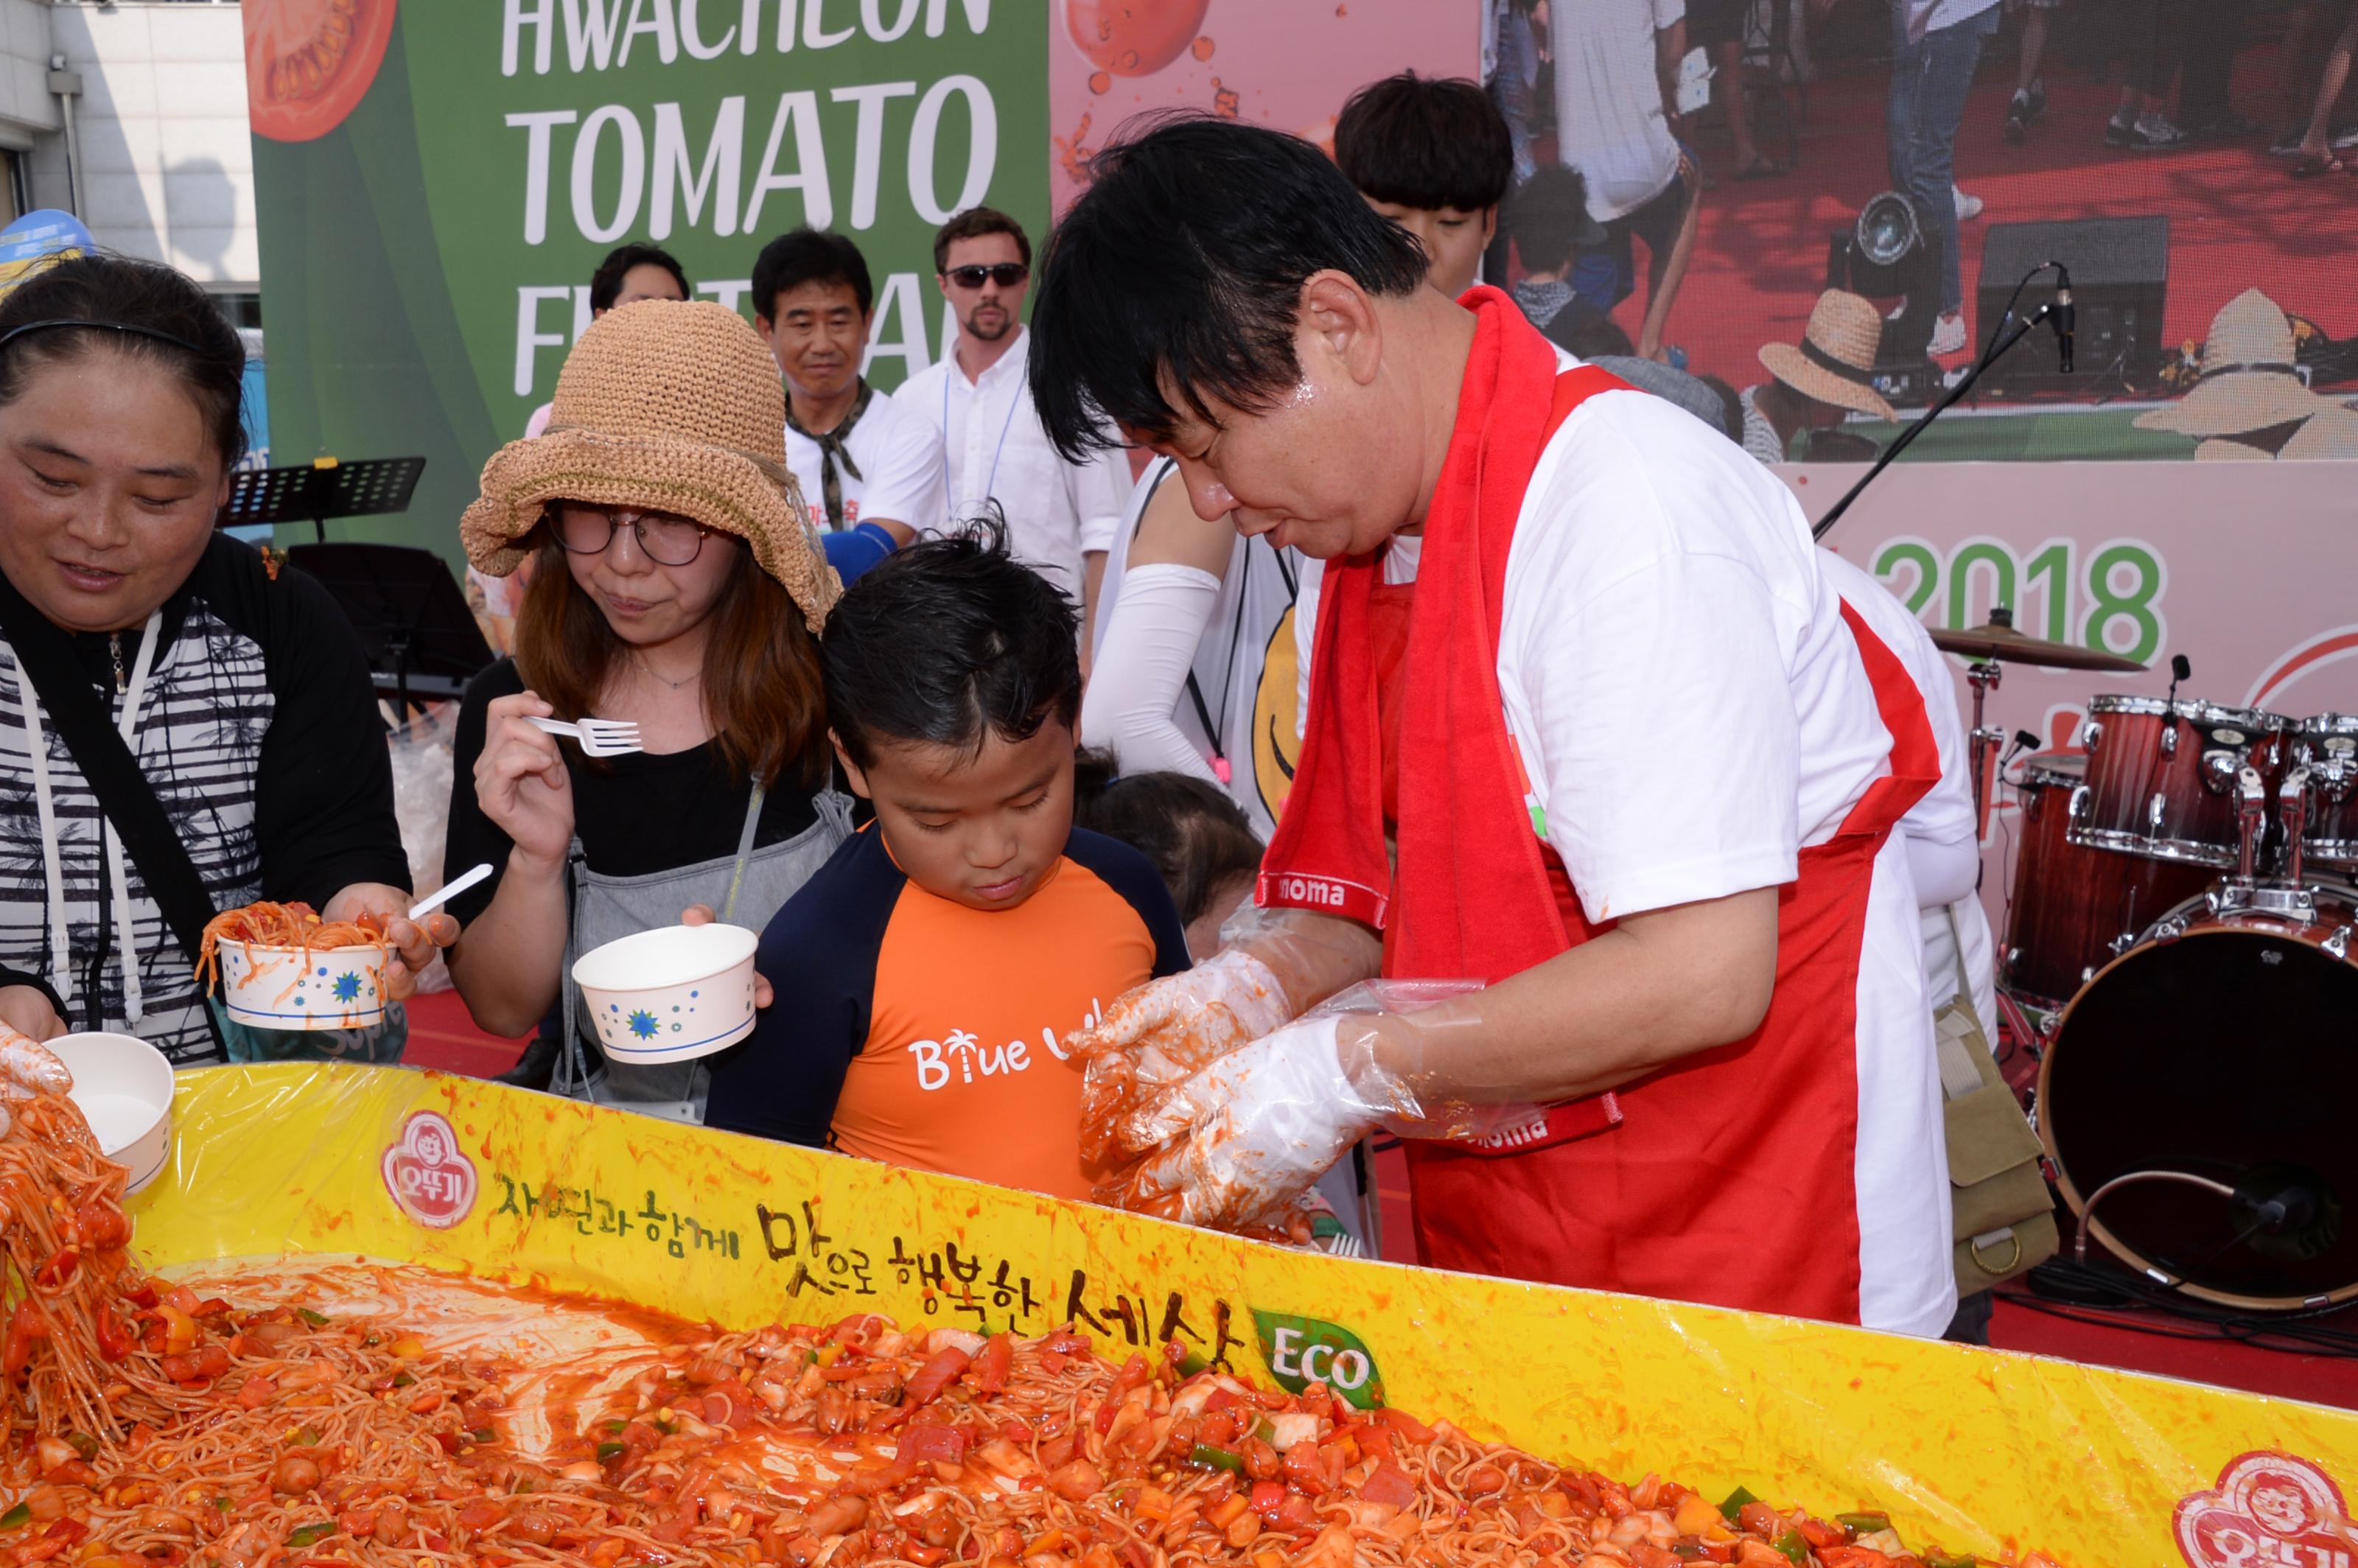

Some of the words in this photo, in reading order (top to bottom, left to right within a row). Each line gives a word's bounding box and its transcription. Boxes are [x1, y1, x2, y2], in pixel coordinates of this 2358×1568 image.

[502, 0, 990, 77] HWAC
[505, 74, 998, 246] TOMATO
[1872, 538, 2165, 672] 2018
[400, 1166, 461, 1205] 오뚜기
[493, 1172, 634, 1238] 자연과
[638, 1190, 740, 1260] 함께
[756, 1200, 877, 1298] 맛으로
[888, 1236, 1041, 1338] 행복한
[1066, 1269, 1246, 1375] 세상
[1273, 1327, 1371, 1390] ECO
